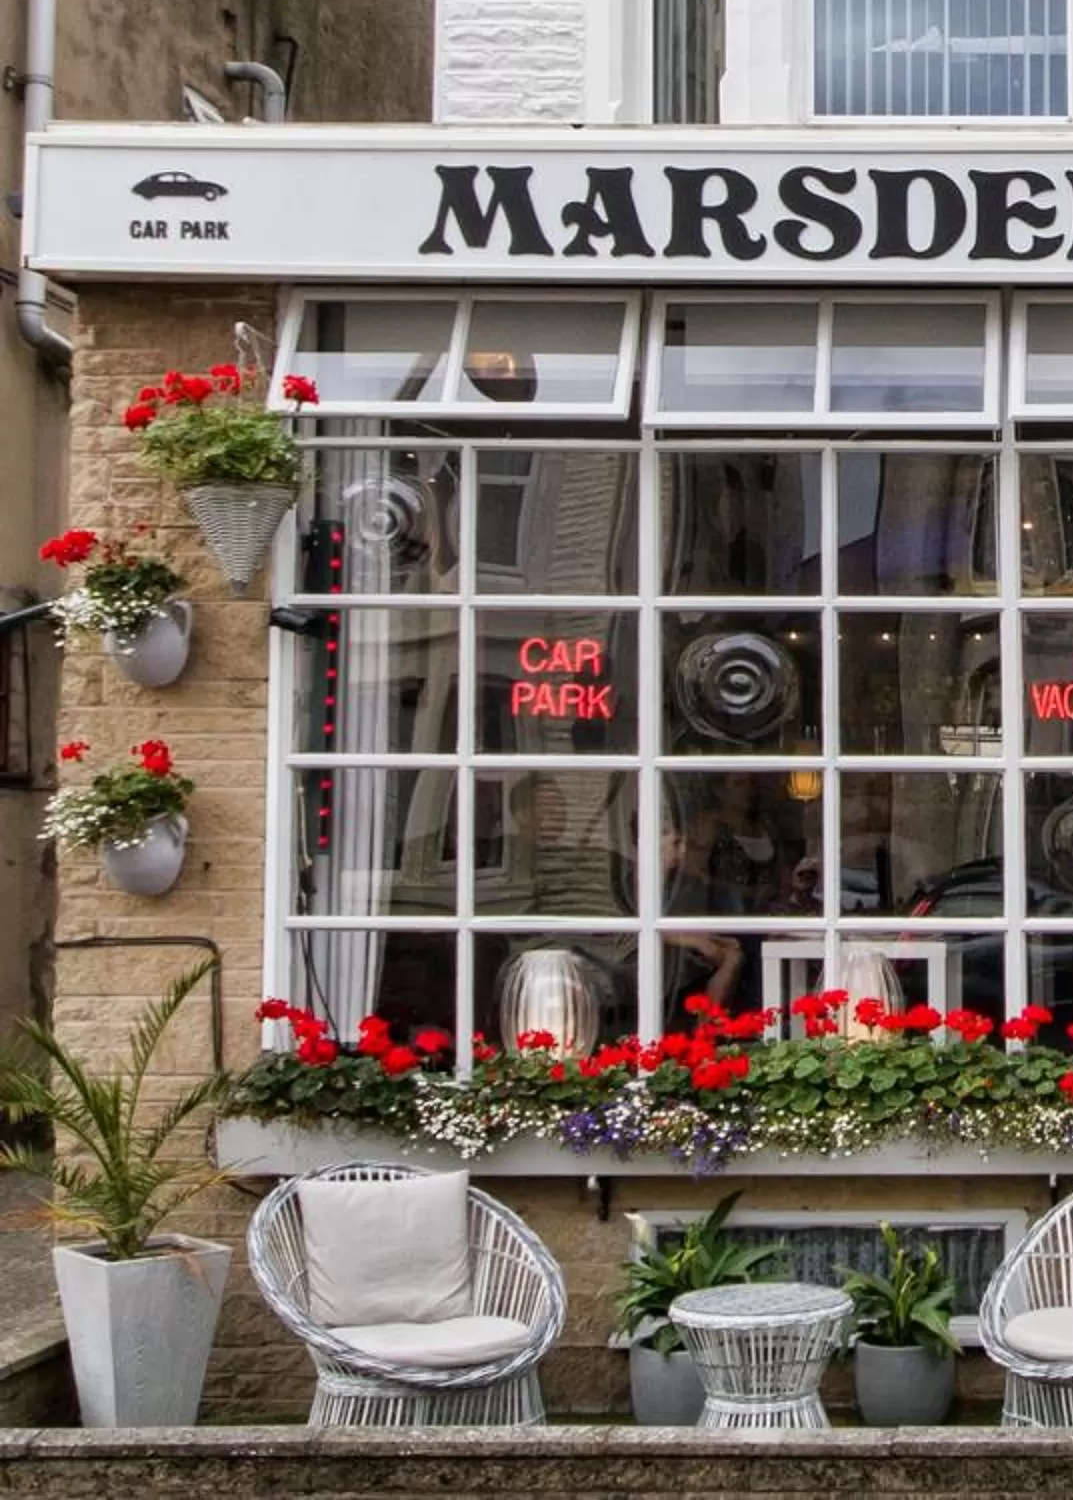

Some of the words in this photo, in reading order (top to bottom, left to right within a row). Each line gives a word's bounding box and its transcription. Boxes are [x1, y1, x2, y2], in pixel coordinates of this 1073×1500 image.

[129, 220, 168, 240] CAR
[180, 220, 230, 240] PARK
[518, 637, 602, 675] CAR
[511, 681, 612, 720] PARK
